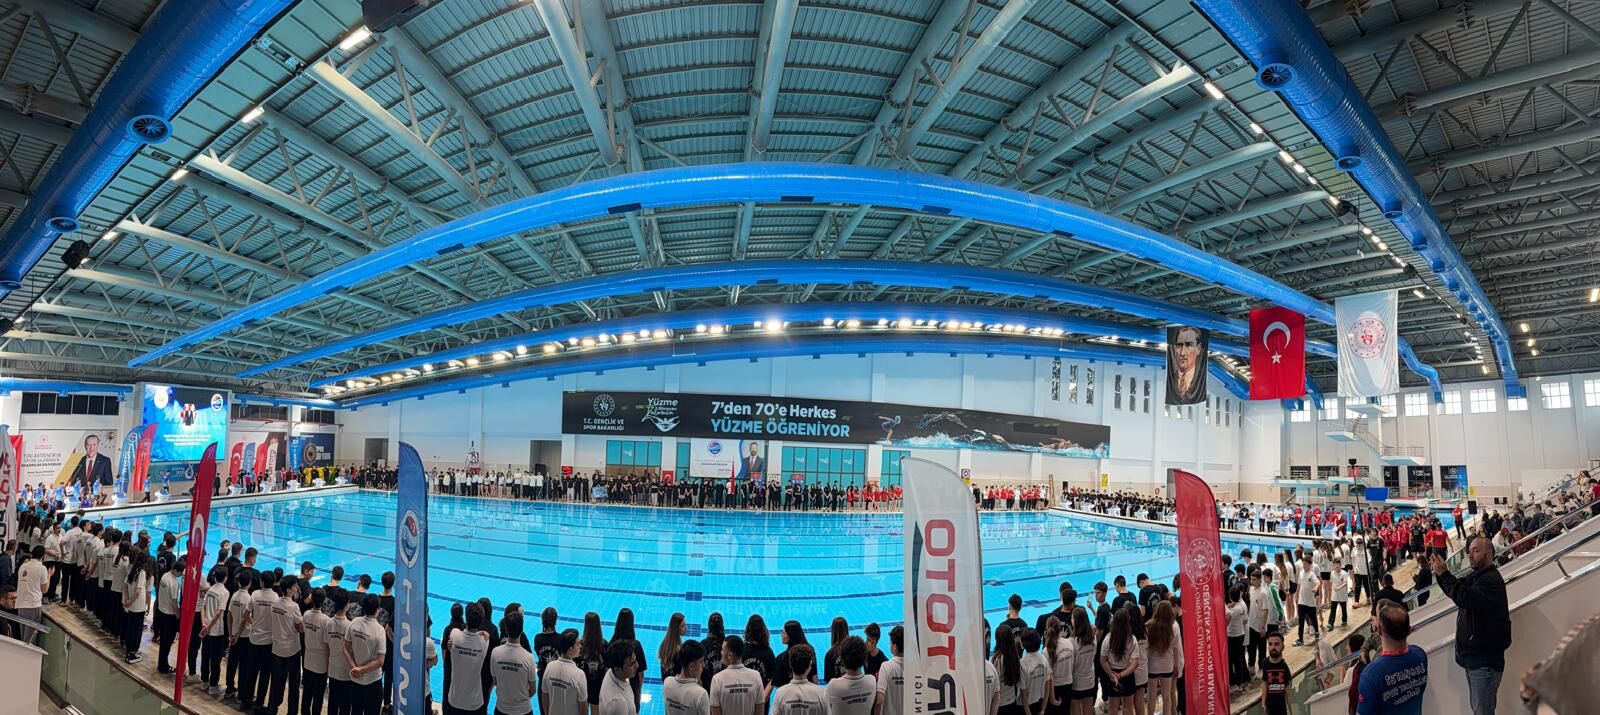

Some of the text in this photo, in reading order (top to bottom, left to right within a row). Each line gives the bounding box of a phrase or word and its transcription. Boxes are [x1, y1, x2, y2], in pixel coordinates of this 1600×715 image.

[647, 397, 679, 407] Yüzme
[789, 404, 837, 419] Herkes
[593, 418, 616, 426] GENÇLİK
[711, 416, 850, 438] YÜZME ÖĞRENİYOR
